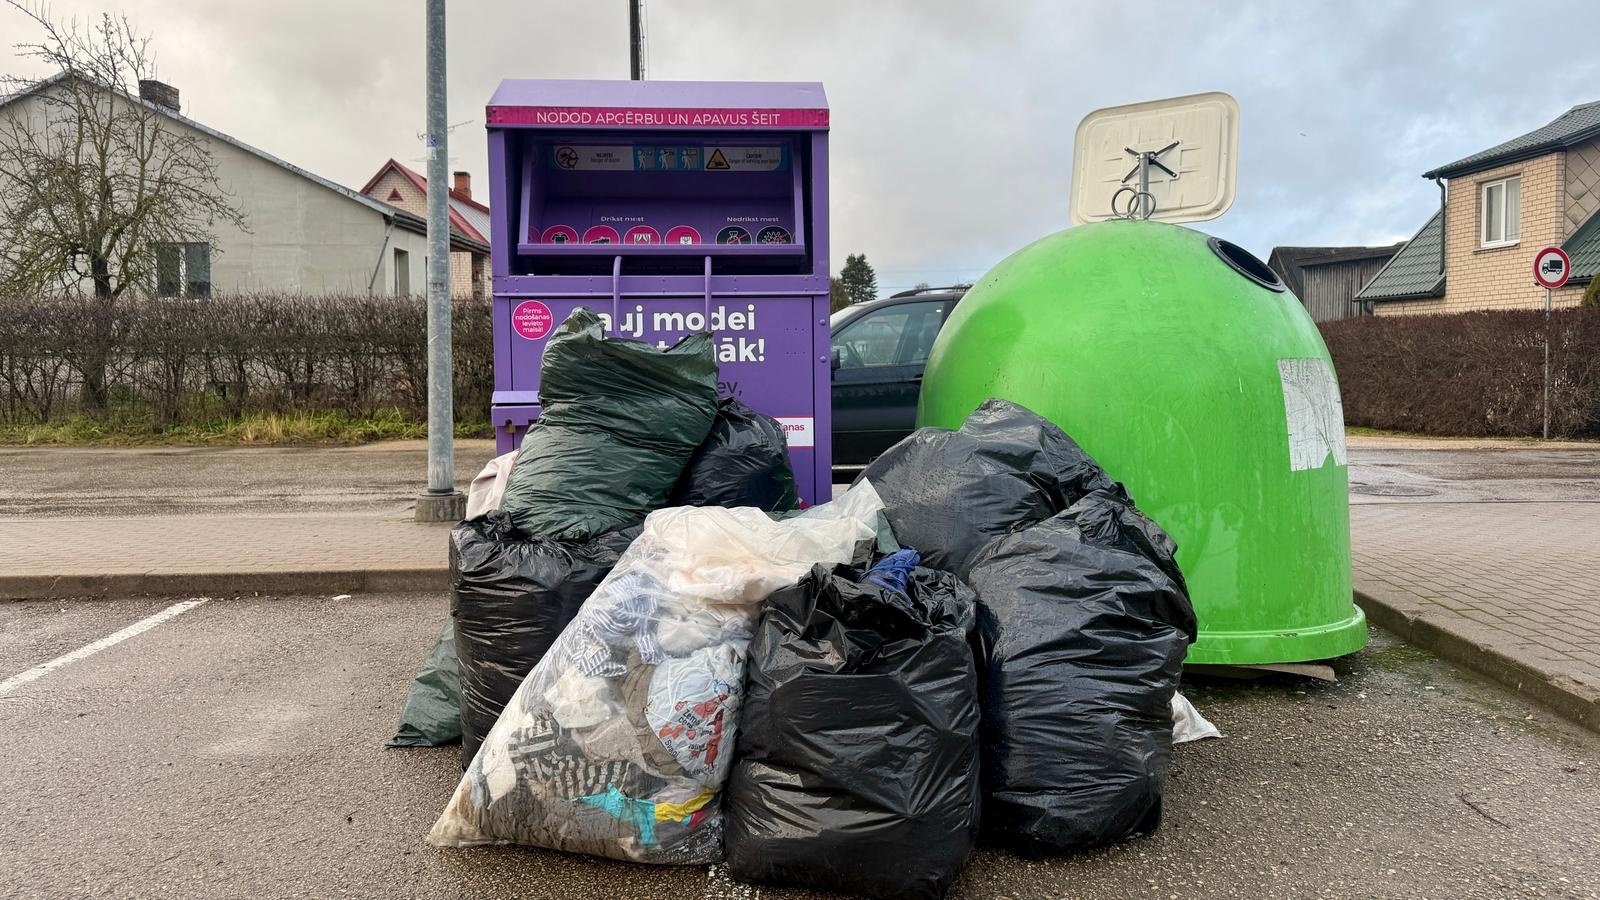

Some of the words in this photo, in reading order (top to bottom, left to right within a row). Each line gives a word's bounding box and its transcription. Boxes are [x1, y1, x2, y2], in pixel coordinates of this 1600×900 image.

[536, 111, 592, 124] NODOD
[595, 110, 664, 126] APĢĒRBU
[667, 113, 689, 125] UN
[692, 113, 748, 126] APAVUS
[751, 111, 781, 125] ŠEIT
[597, 304, 645, 338] auj
[653, 304, 755, 332] modei
[713, 337, 766, 363] āk!
[717, 381, 743, 396] ev,
[780, 423, 805, 432] anas
